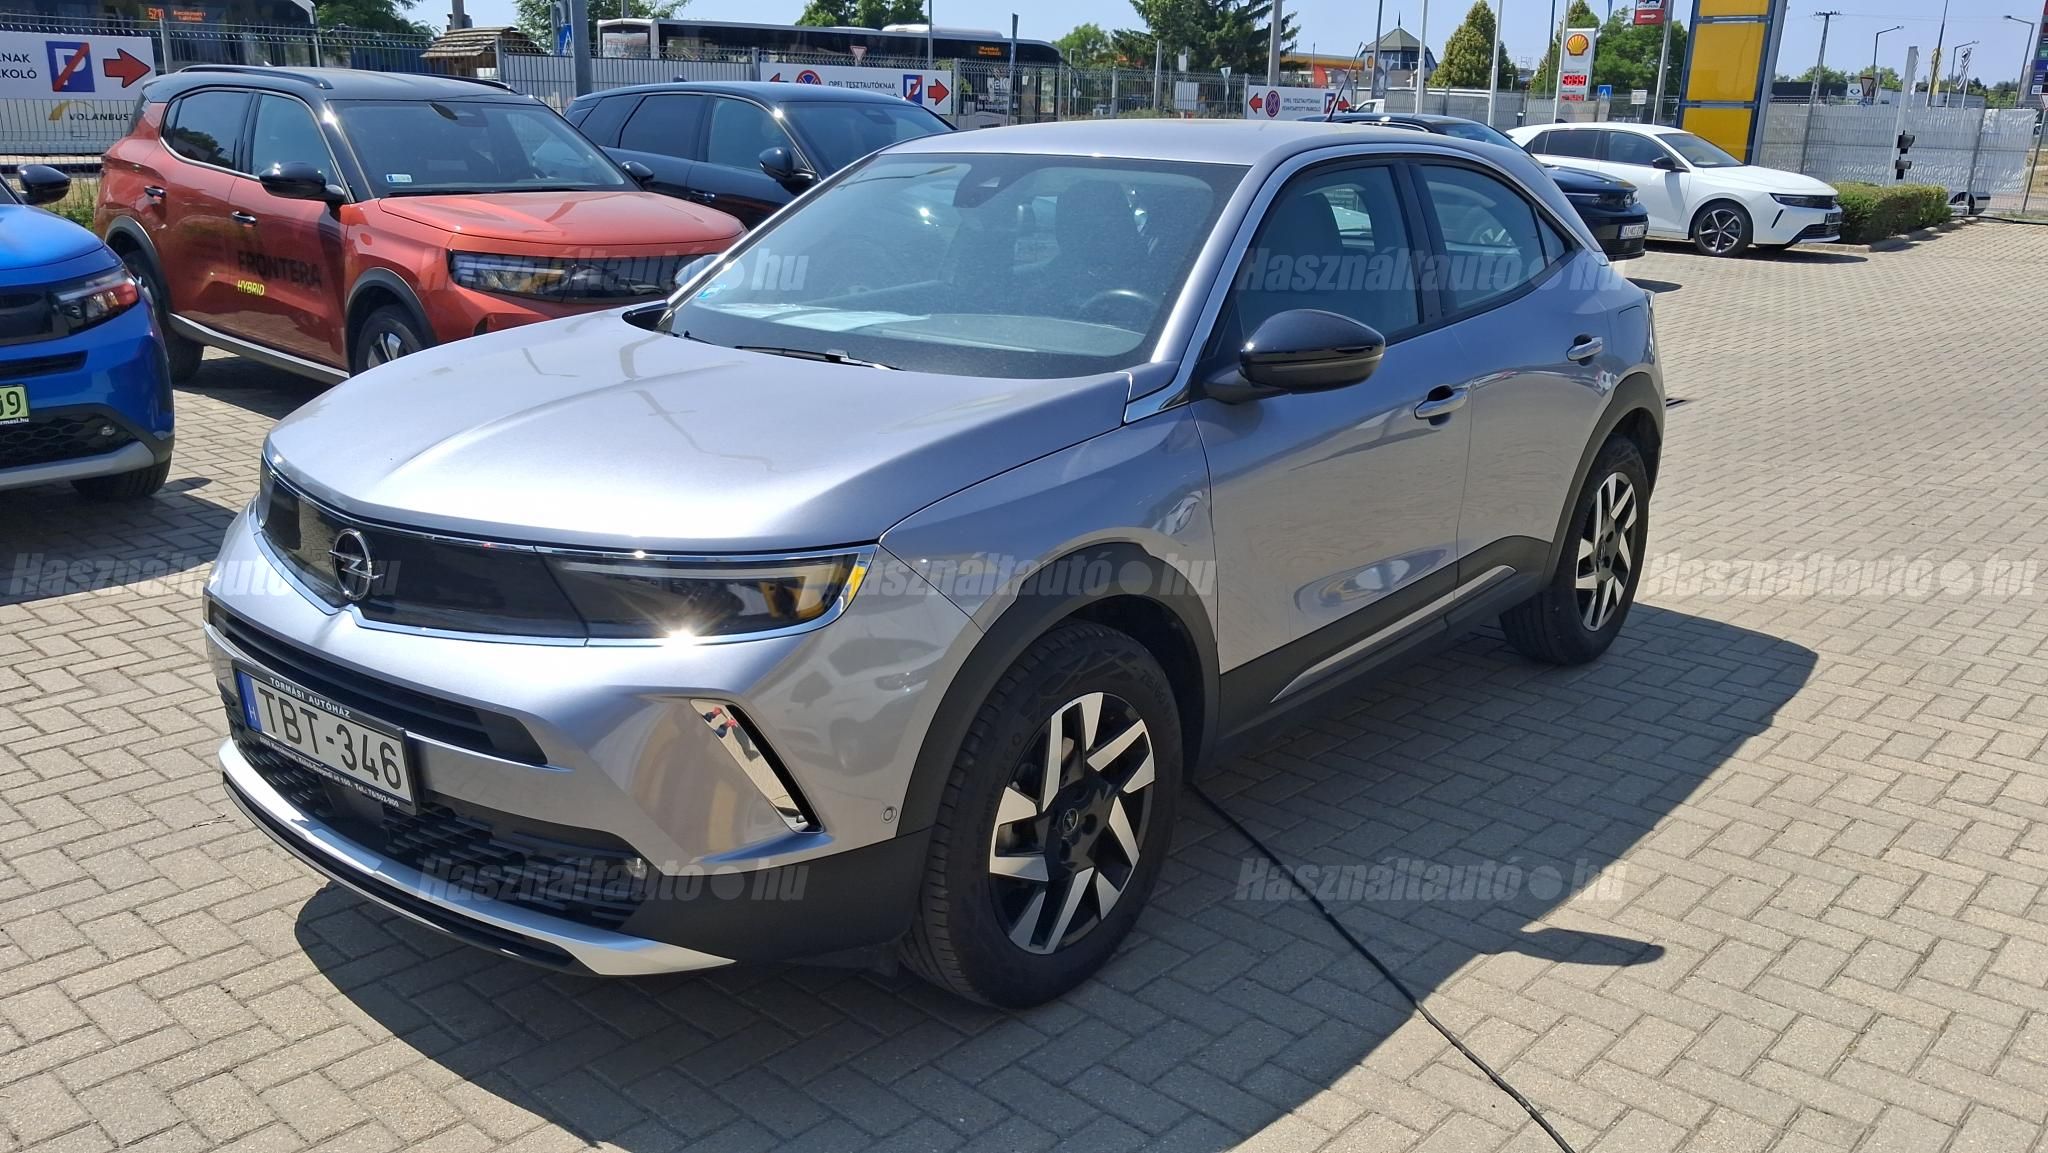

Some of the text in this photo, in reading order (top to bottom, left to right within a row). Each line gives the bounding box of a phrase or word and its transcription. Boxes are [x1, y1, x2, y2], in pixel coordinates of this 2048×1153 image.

[0, 53, 31, 63] NAK
[0, 67, 37, 79] KOLÓ
[846, 80, 896, 89] TESZTAUTÓKNAK
[238, 250, 321, 287] FRONTERA
[237, 280, 264, 296] HYBRID
[269, 677, 352, 719] TORMÁSI AUTÓHÁZ
[247, 703, 257, 721] H
[258, 686, 402, 790] TBT-346
